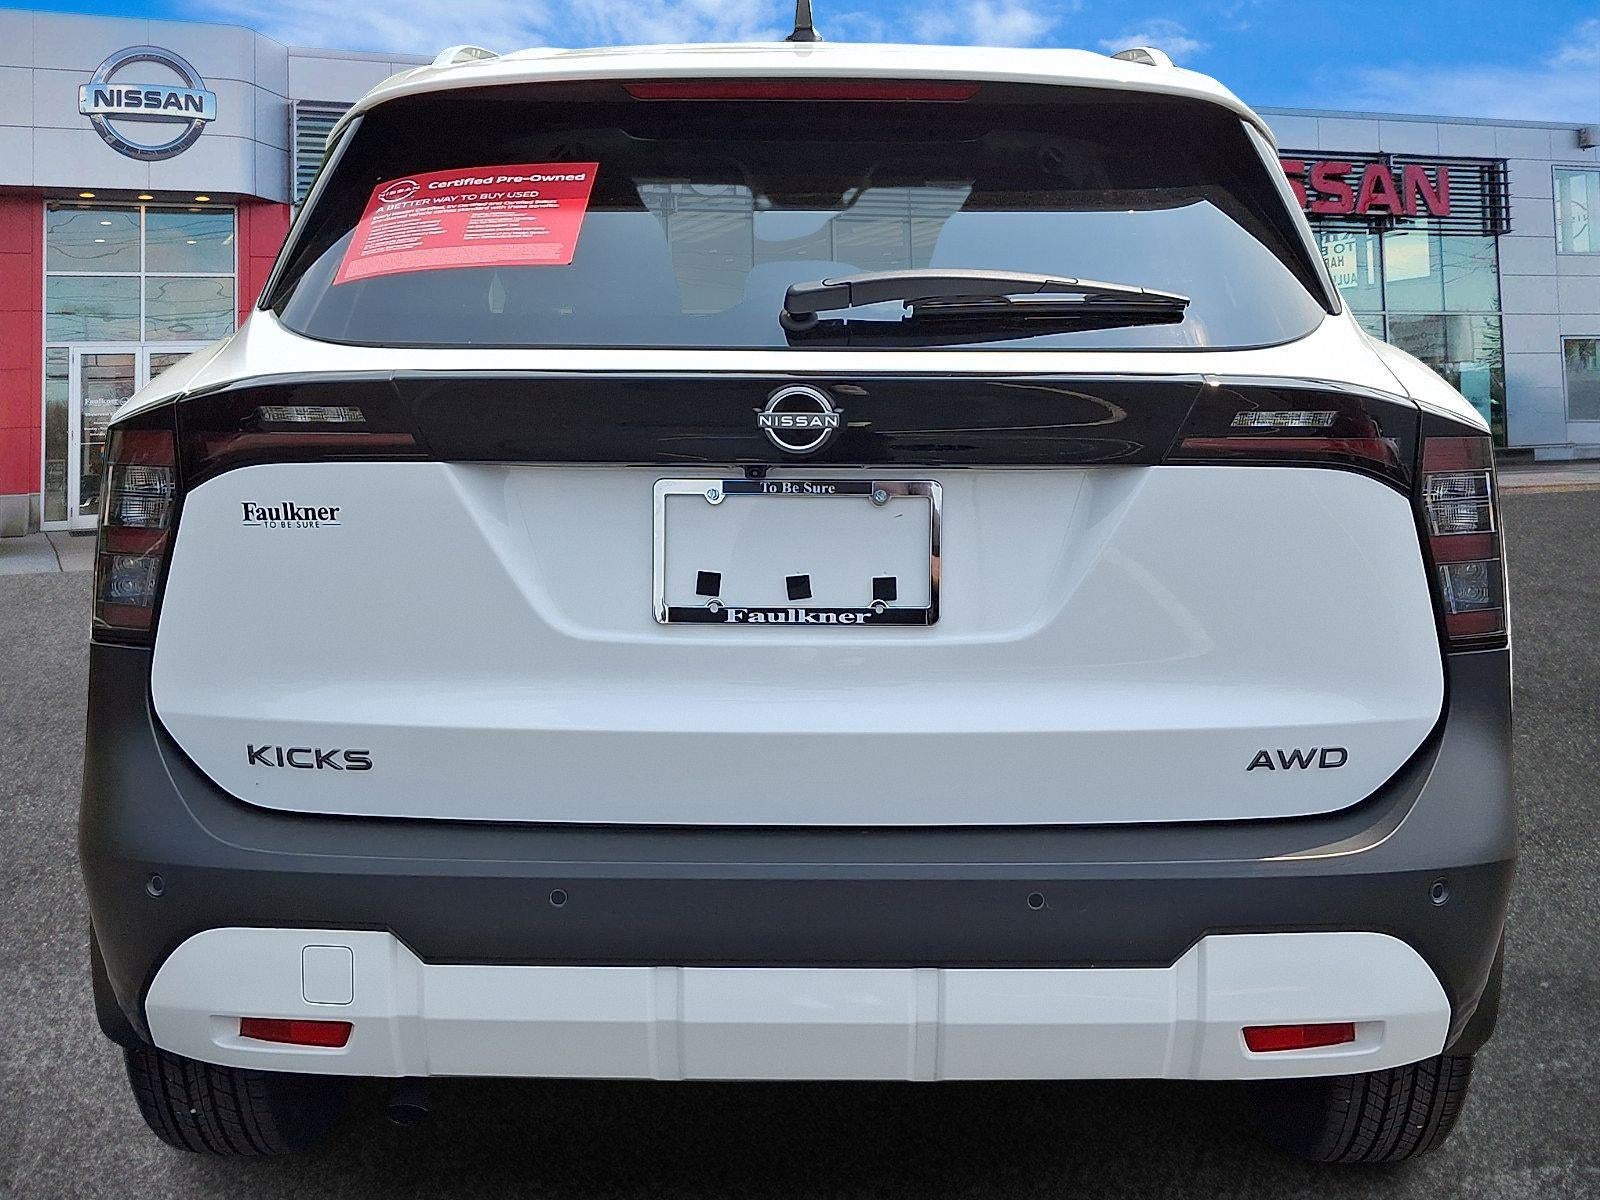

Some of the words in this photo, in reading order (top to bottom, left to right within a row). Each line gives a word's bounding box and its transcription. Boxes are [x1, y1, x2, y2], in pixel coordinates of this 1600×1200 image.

[93, 89, 203, 113] NISSAN
[428, 176, 494, 190] Certified
[496, 173, 586, 185] Pre-Owned
[386, 198, 431, 212] BETTER
[432, 195, 459, 204] WAY
[460, 193, 479, 201] TO
[479, 192, 506, 200] BUY
[507, 190, 540, 198] USED
[759, 415, 838, 427] NISSAN
[760, 482, 777, 493] To
[782, 482, 800, 493] Be
[803, 482, 836, 494] Sure
[241, 501, 340, 521] Faulkner
[724, 608, 871, 624] Faulkner
[246, 743, 373, 771] KICKS
[1246, 747, 1348, 771] AWD
